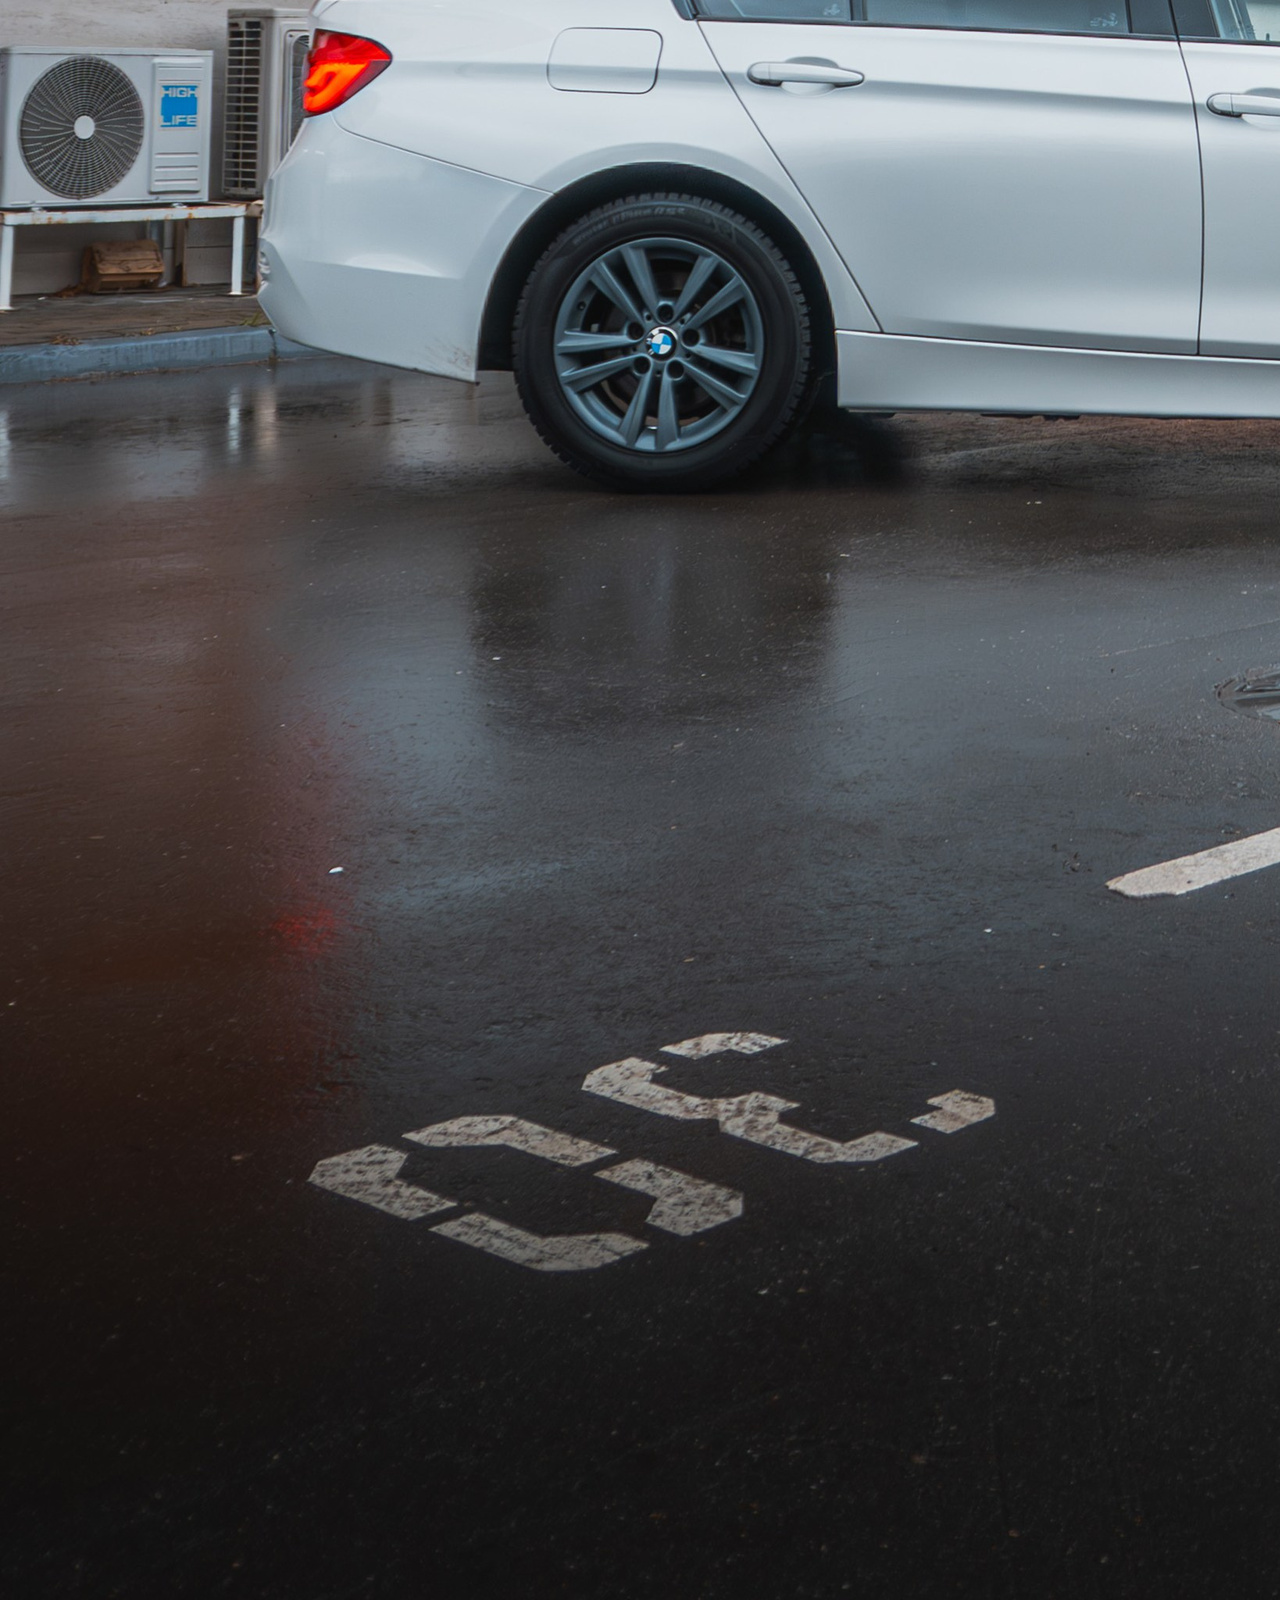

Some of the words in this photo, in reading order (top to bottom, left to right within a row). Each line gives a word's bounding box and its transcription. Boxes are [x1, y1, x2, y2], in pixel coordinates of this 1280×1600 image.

[161, 87, 198, 98] HIGH
[160, 114, 197, 125] LIFE
[307, 1031, 996, 1272] 30
